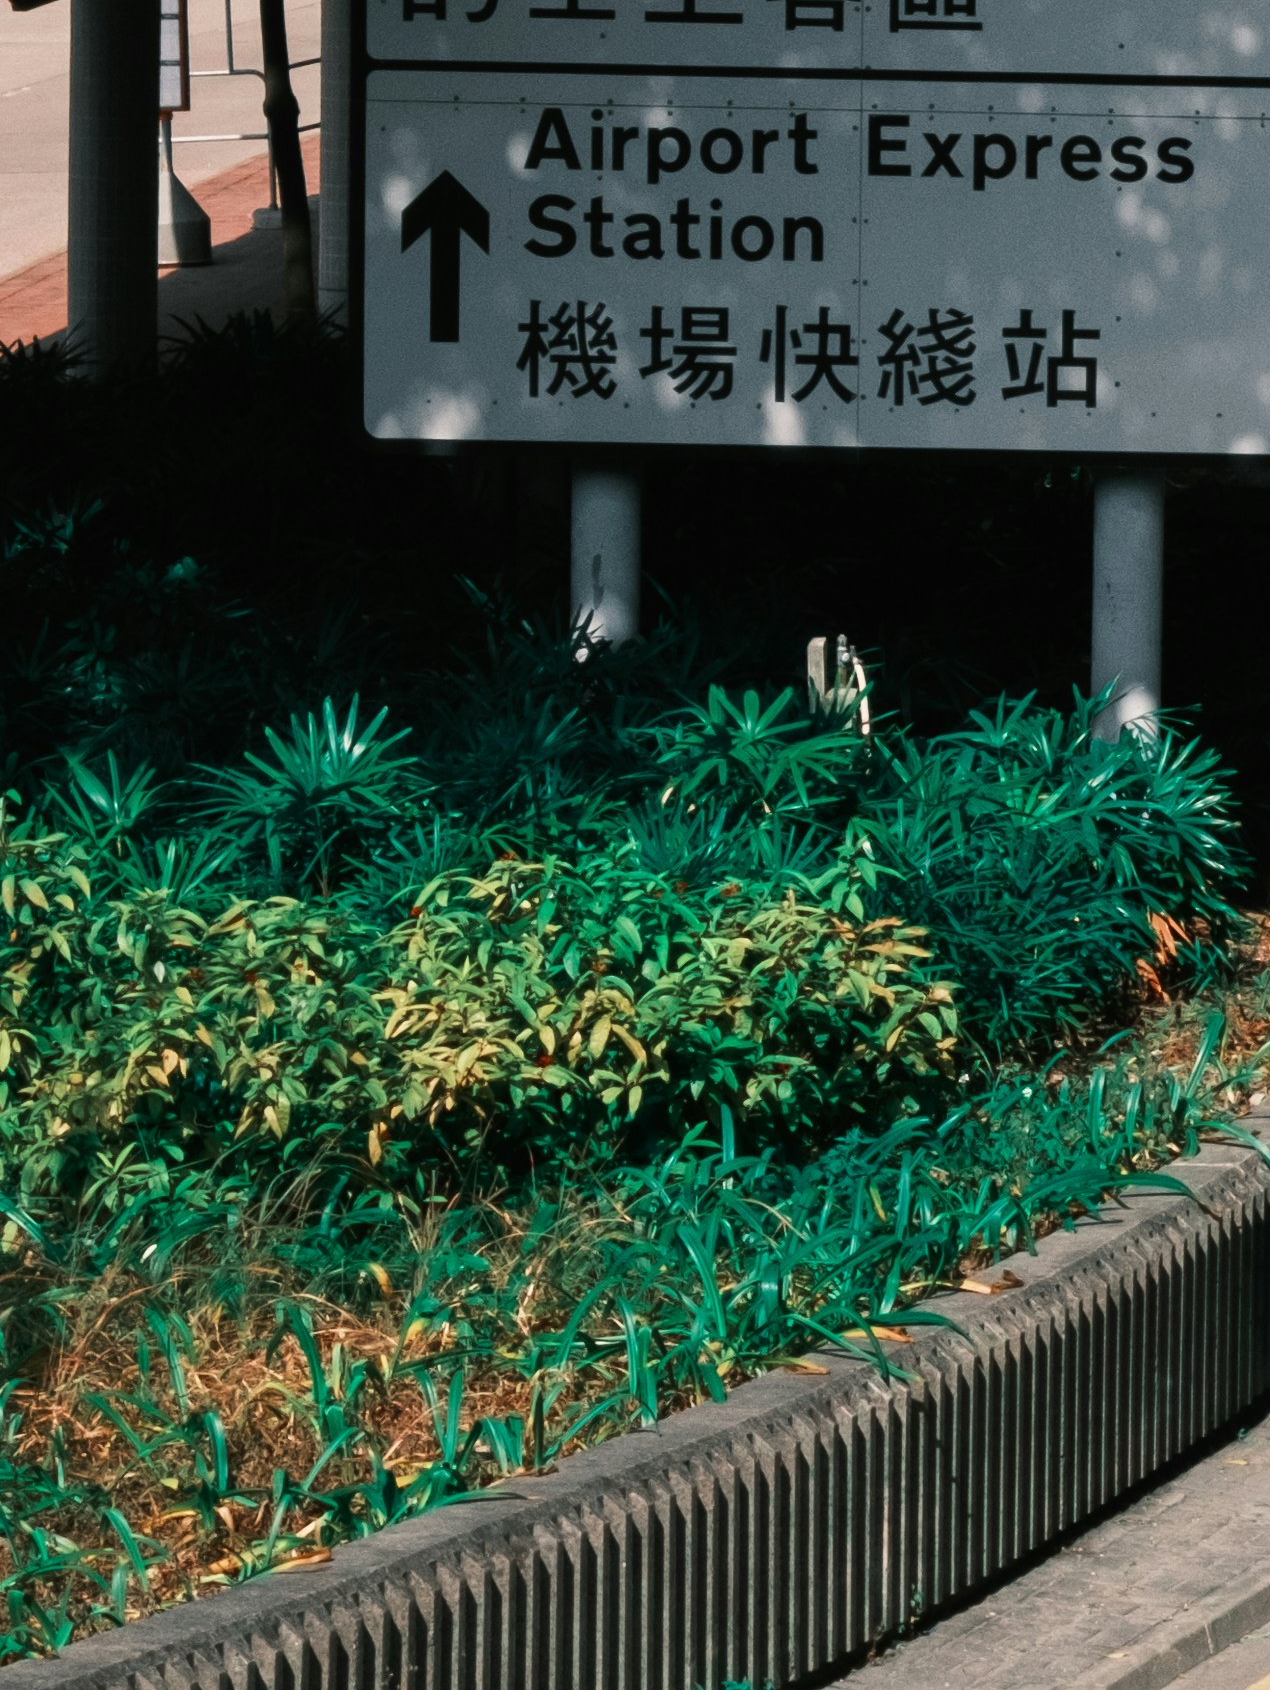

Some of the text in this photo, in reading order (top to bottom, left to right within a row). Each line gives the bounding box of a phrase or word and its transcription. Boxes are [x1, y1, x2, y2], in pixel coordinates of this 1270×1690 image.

[525, 106, 1195, 191] Airport Express
[524, 193, 825, 263] Station
[516, 298, 1101, 409] 機場快綫站
